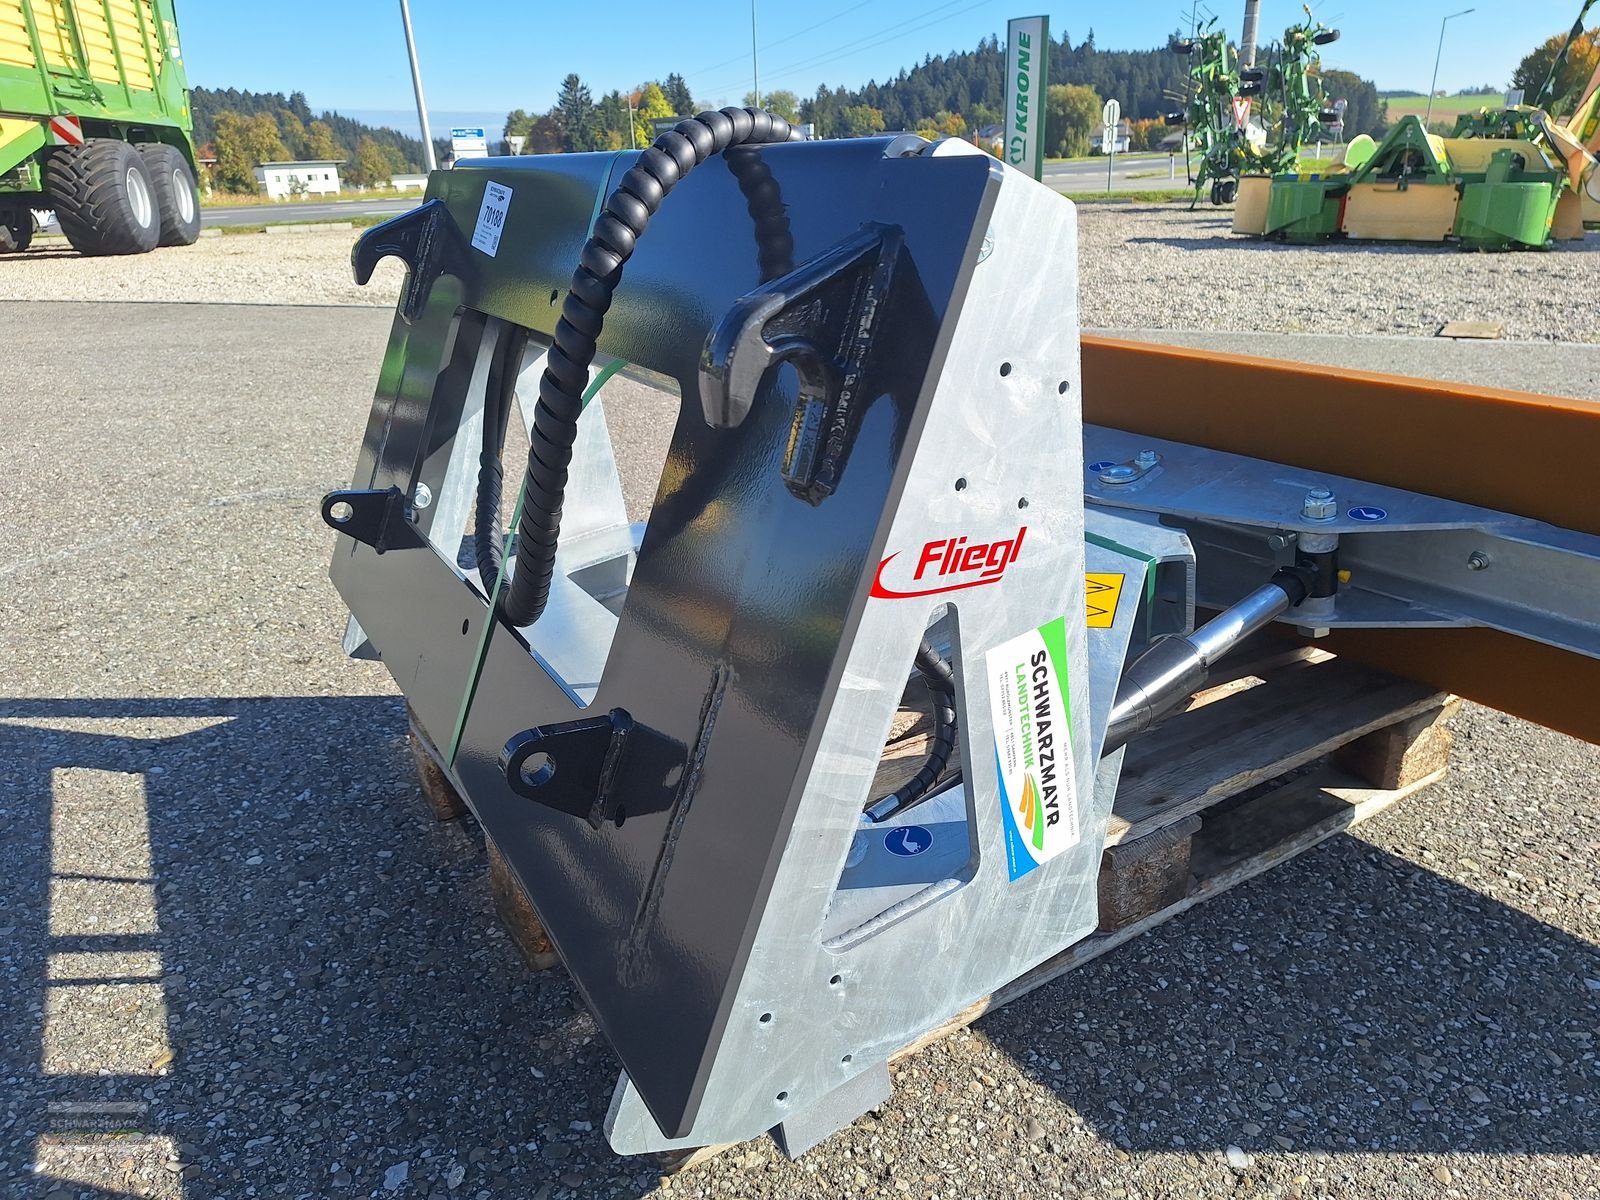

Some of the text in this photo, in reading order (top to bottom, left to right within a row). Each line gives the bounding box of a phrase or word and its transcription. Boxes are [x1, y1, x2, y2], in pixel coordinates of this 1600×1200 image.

[1016, 31, 1031, 133] KRONE
[483, 205, 503, 228] 70188
[913, 526, 1027, 580] Fliegl
[1015, 663, 1035, 770] LANDTECHNIK
[1031, 650, 1060, 828] SCHWARZMAYR
